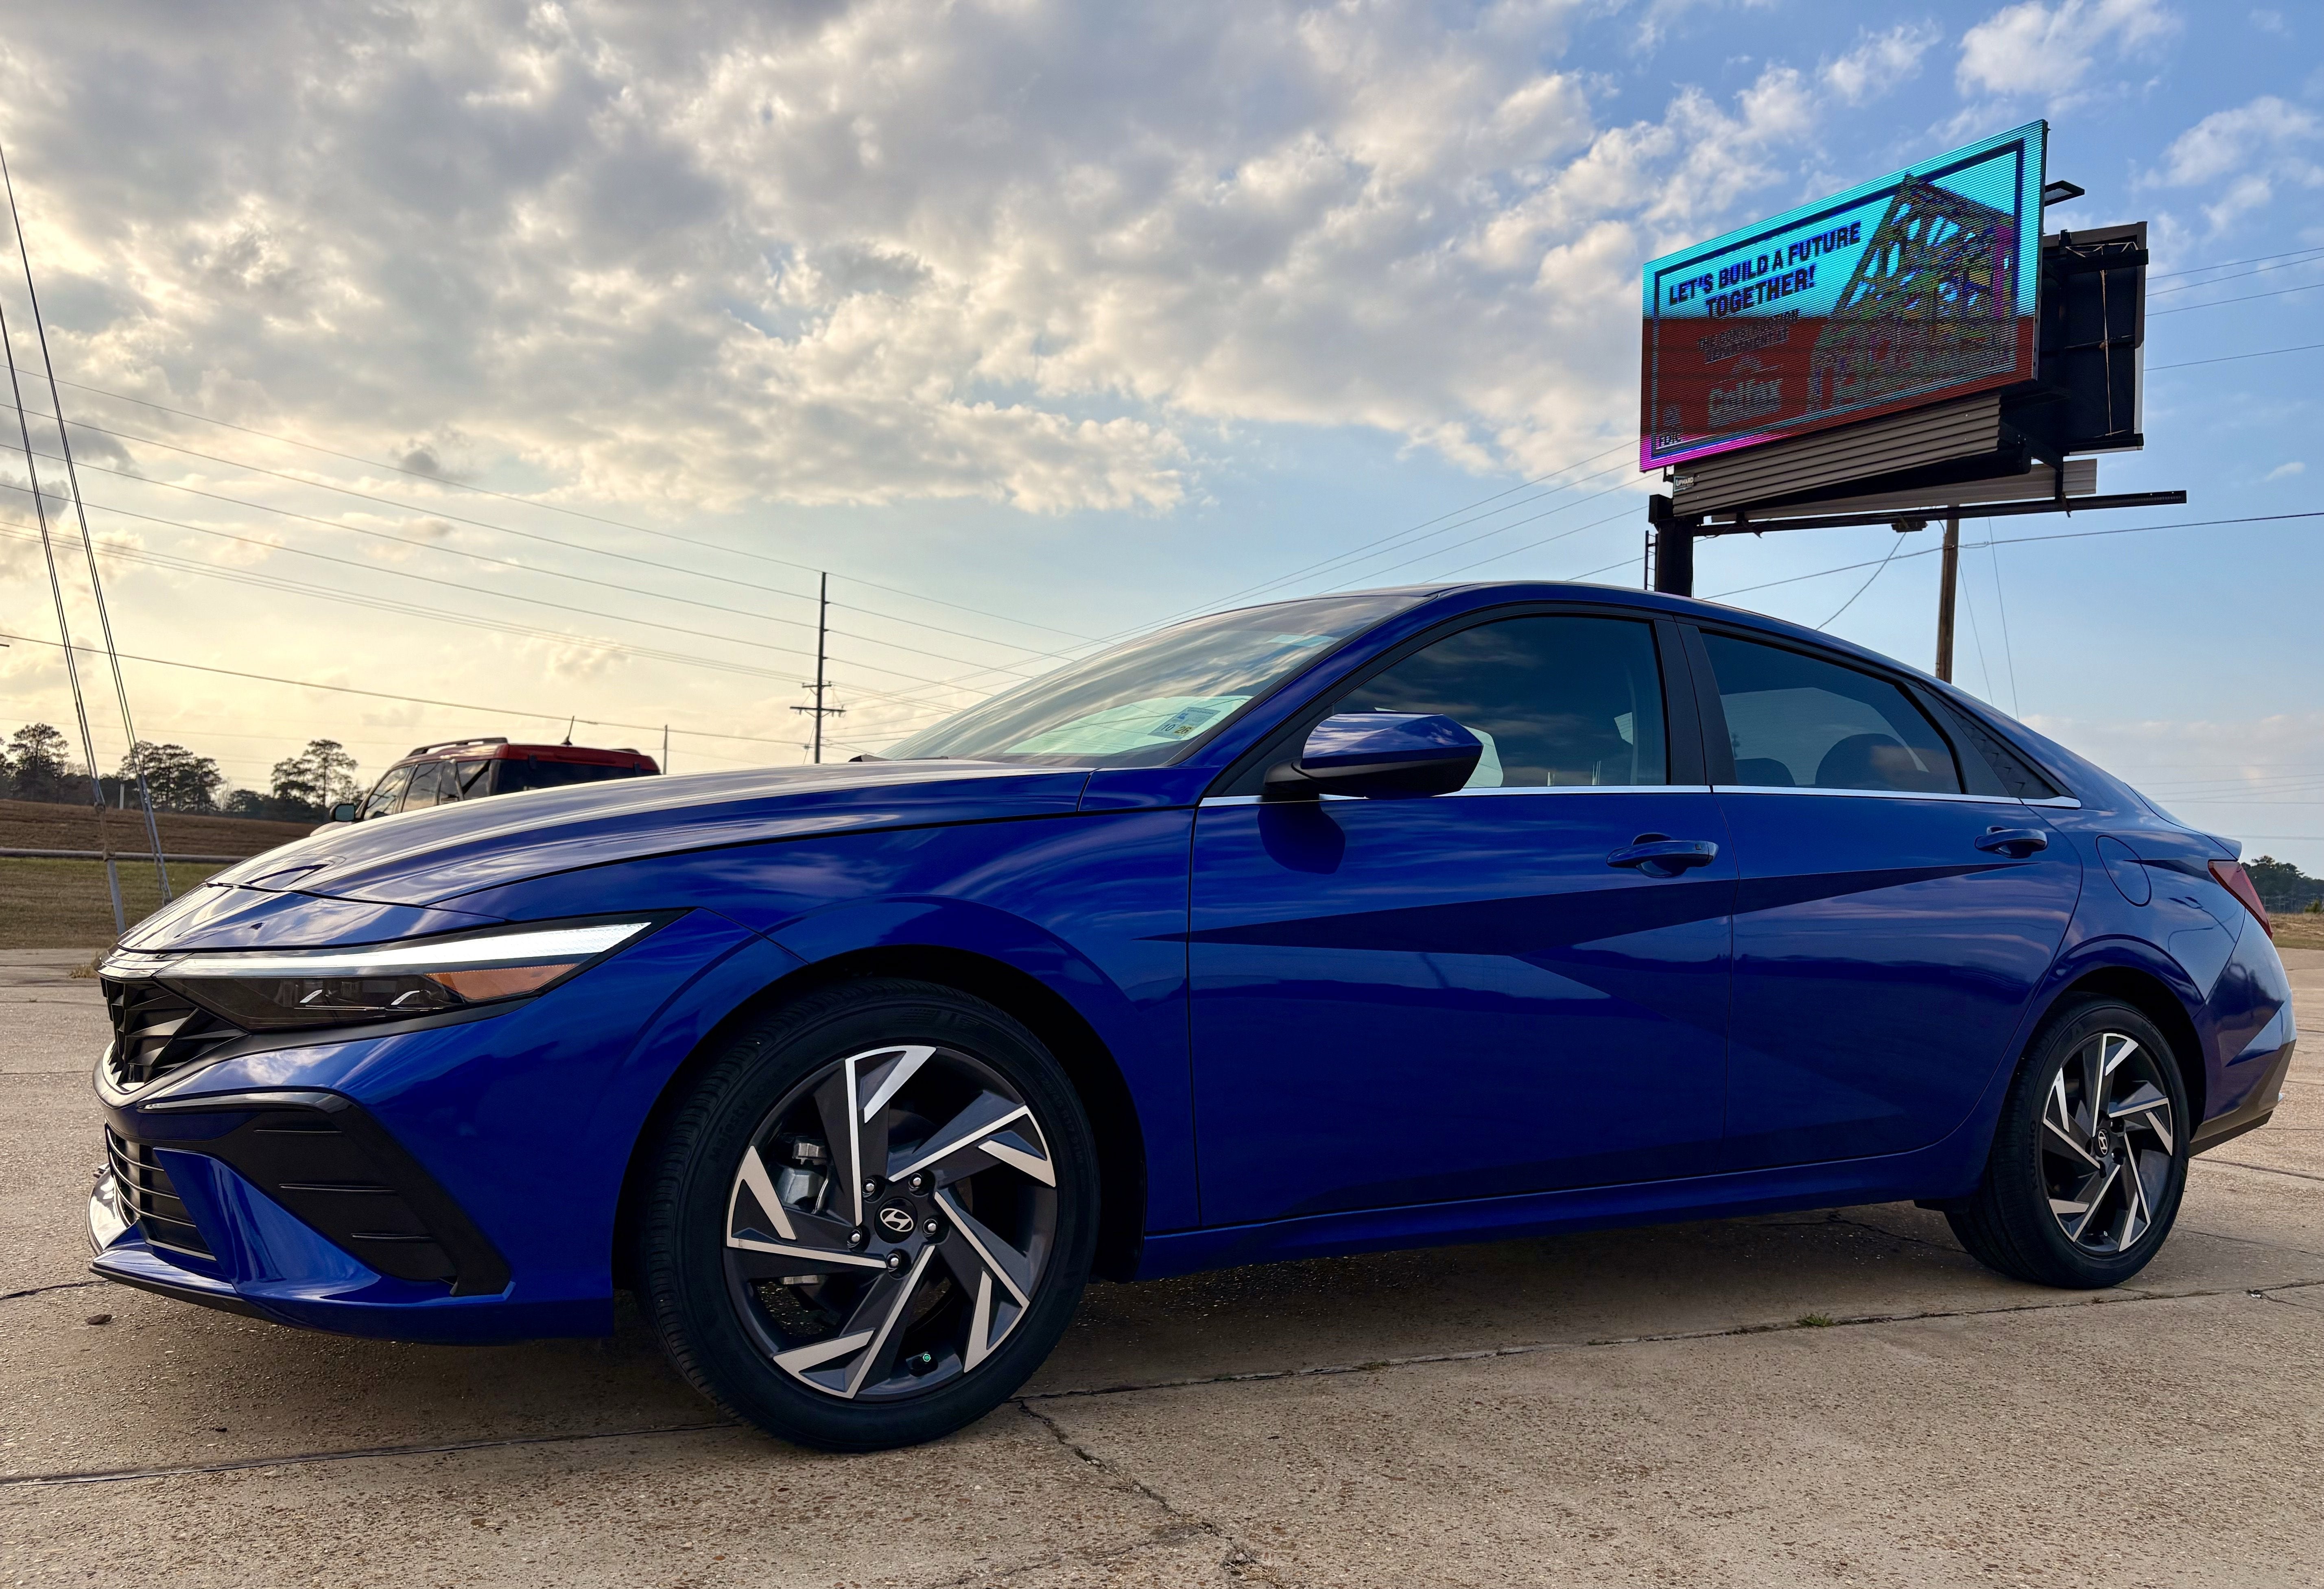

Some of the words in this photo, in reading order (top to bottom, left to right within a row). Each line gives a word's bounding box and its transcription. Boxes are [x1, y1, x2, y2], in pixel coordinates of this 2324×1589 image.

[1669, 273, 1713, 306] LET'S
[1718, 255, 1769, 289] BUILD
[1772, 249, 1784, 271] A
[1788, 220, 1861, 266] FUTURE
[1706, 264, 1815, 319] TOGETHER!
[1174, 726, 1193, 734] 26
[2028, 1120, 2038, 1191] KUMHO
